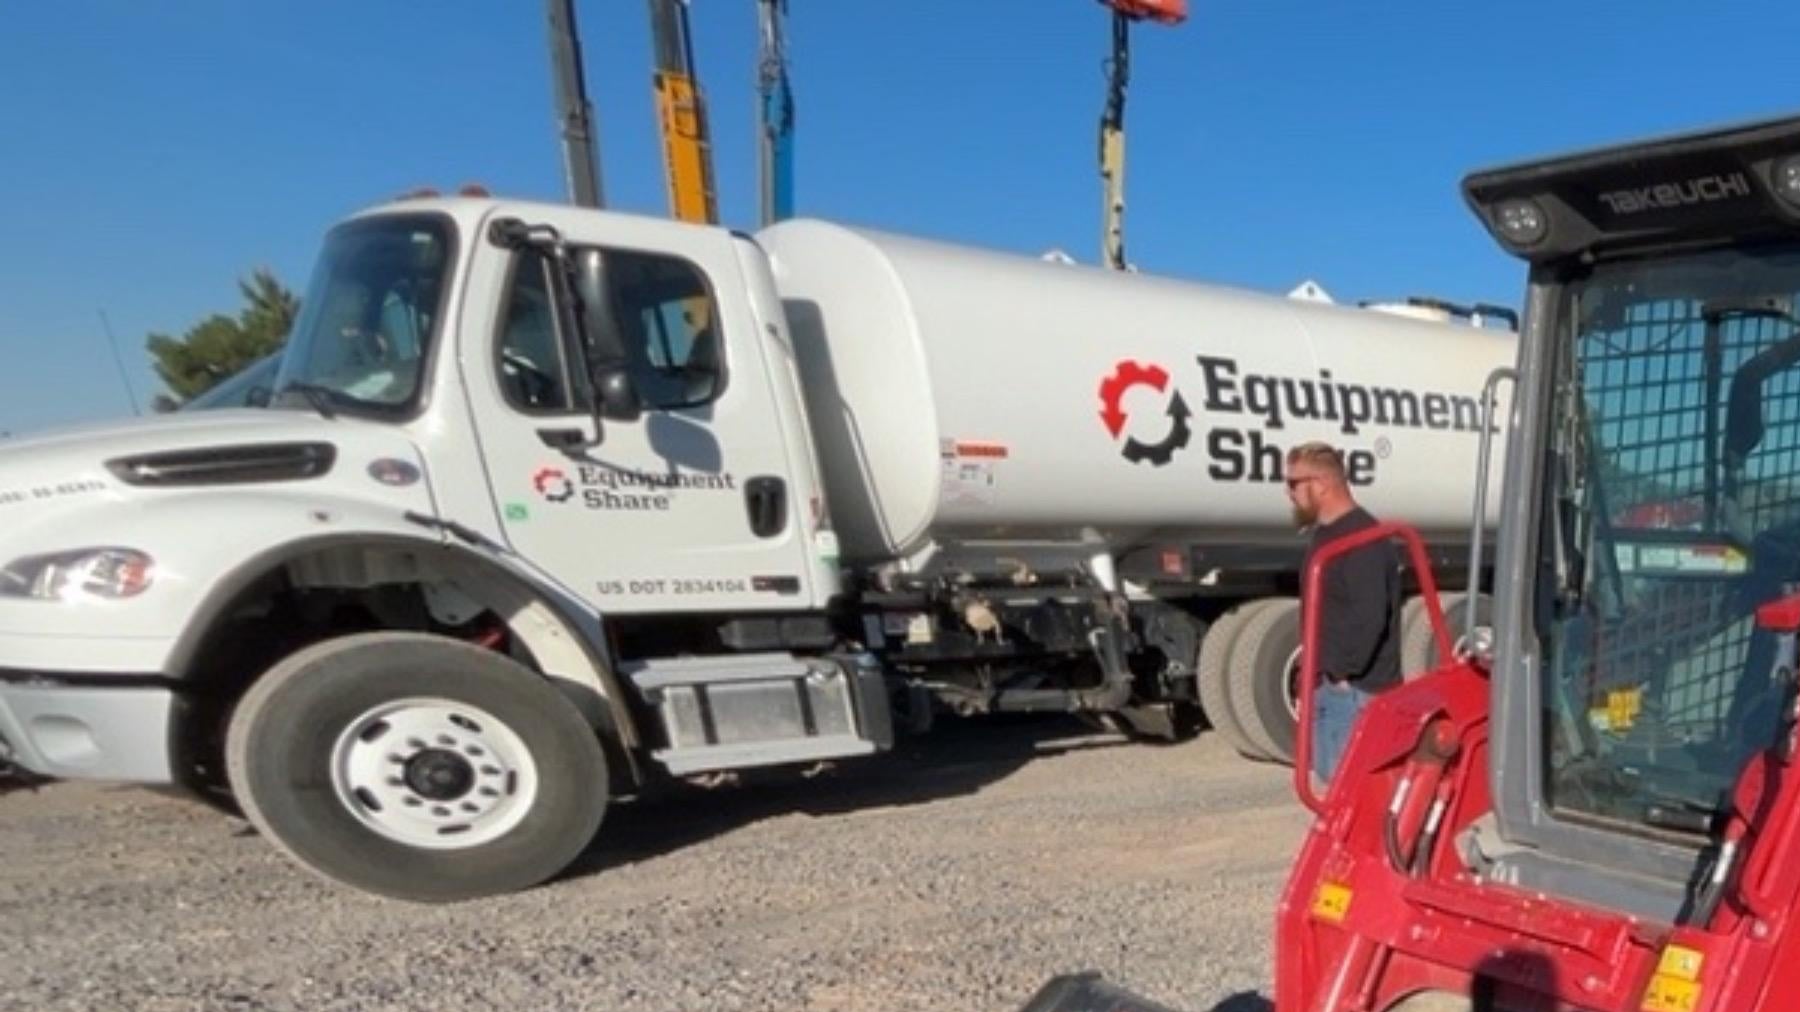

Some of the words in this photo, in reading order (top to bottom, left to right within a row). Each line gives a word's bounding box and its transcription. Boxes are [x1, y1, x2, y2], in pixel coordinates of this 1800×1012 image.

[1197, 354, 1500, 434] Equipment
[1207, 427, 1375, 486] She
[578, 466, 737, 491] Equipment
[583, 489, 669, 510] Share
[597, 579, 624, 595] US
[629, 579, 666, 595] DOT
[673, 578, 745, 594] 2834104
